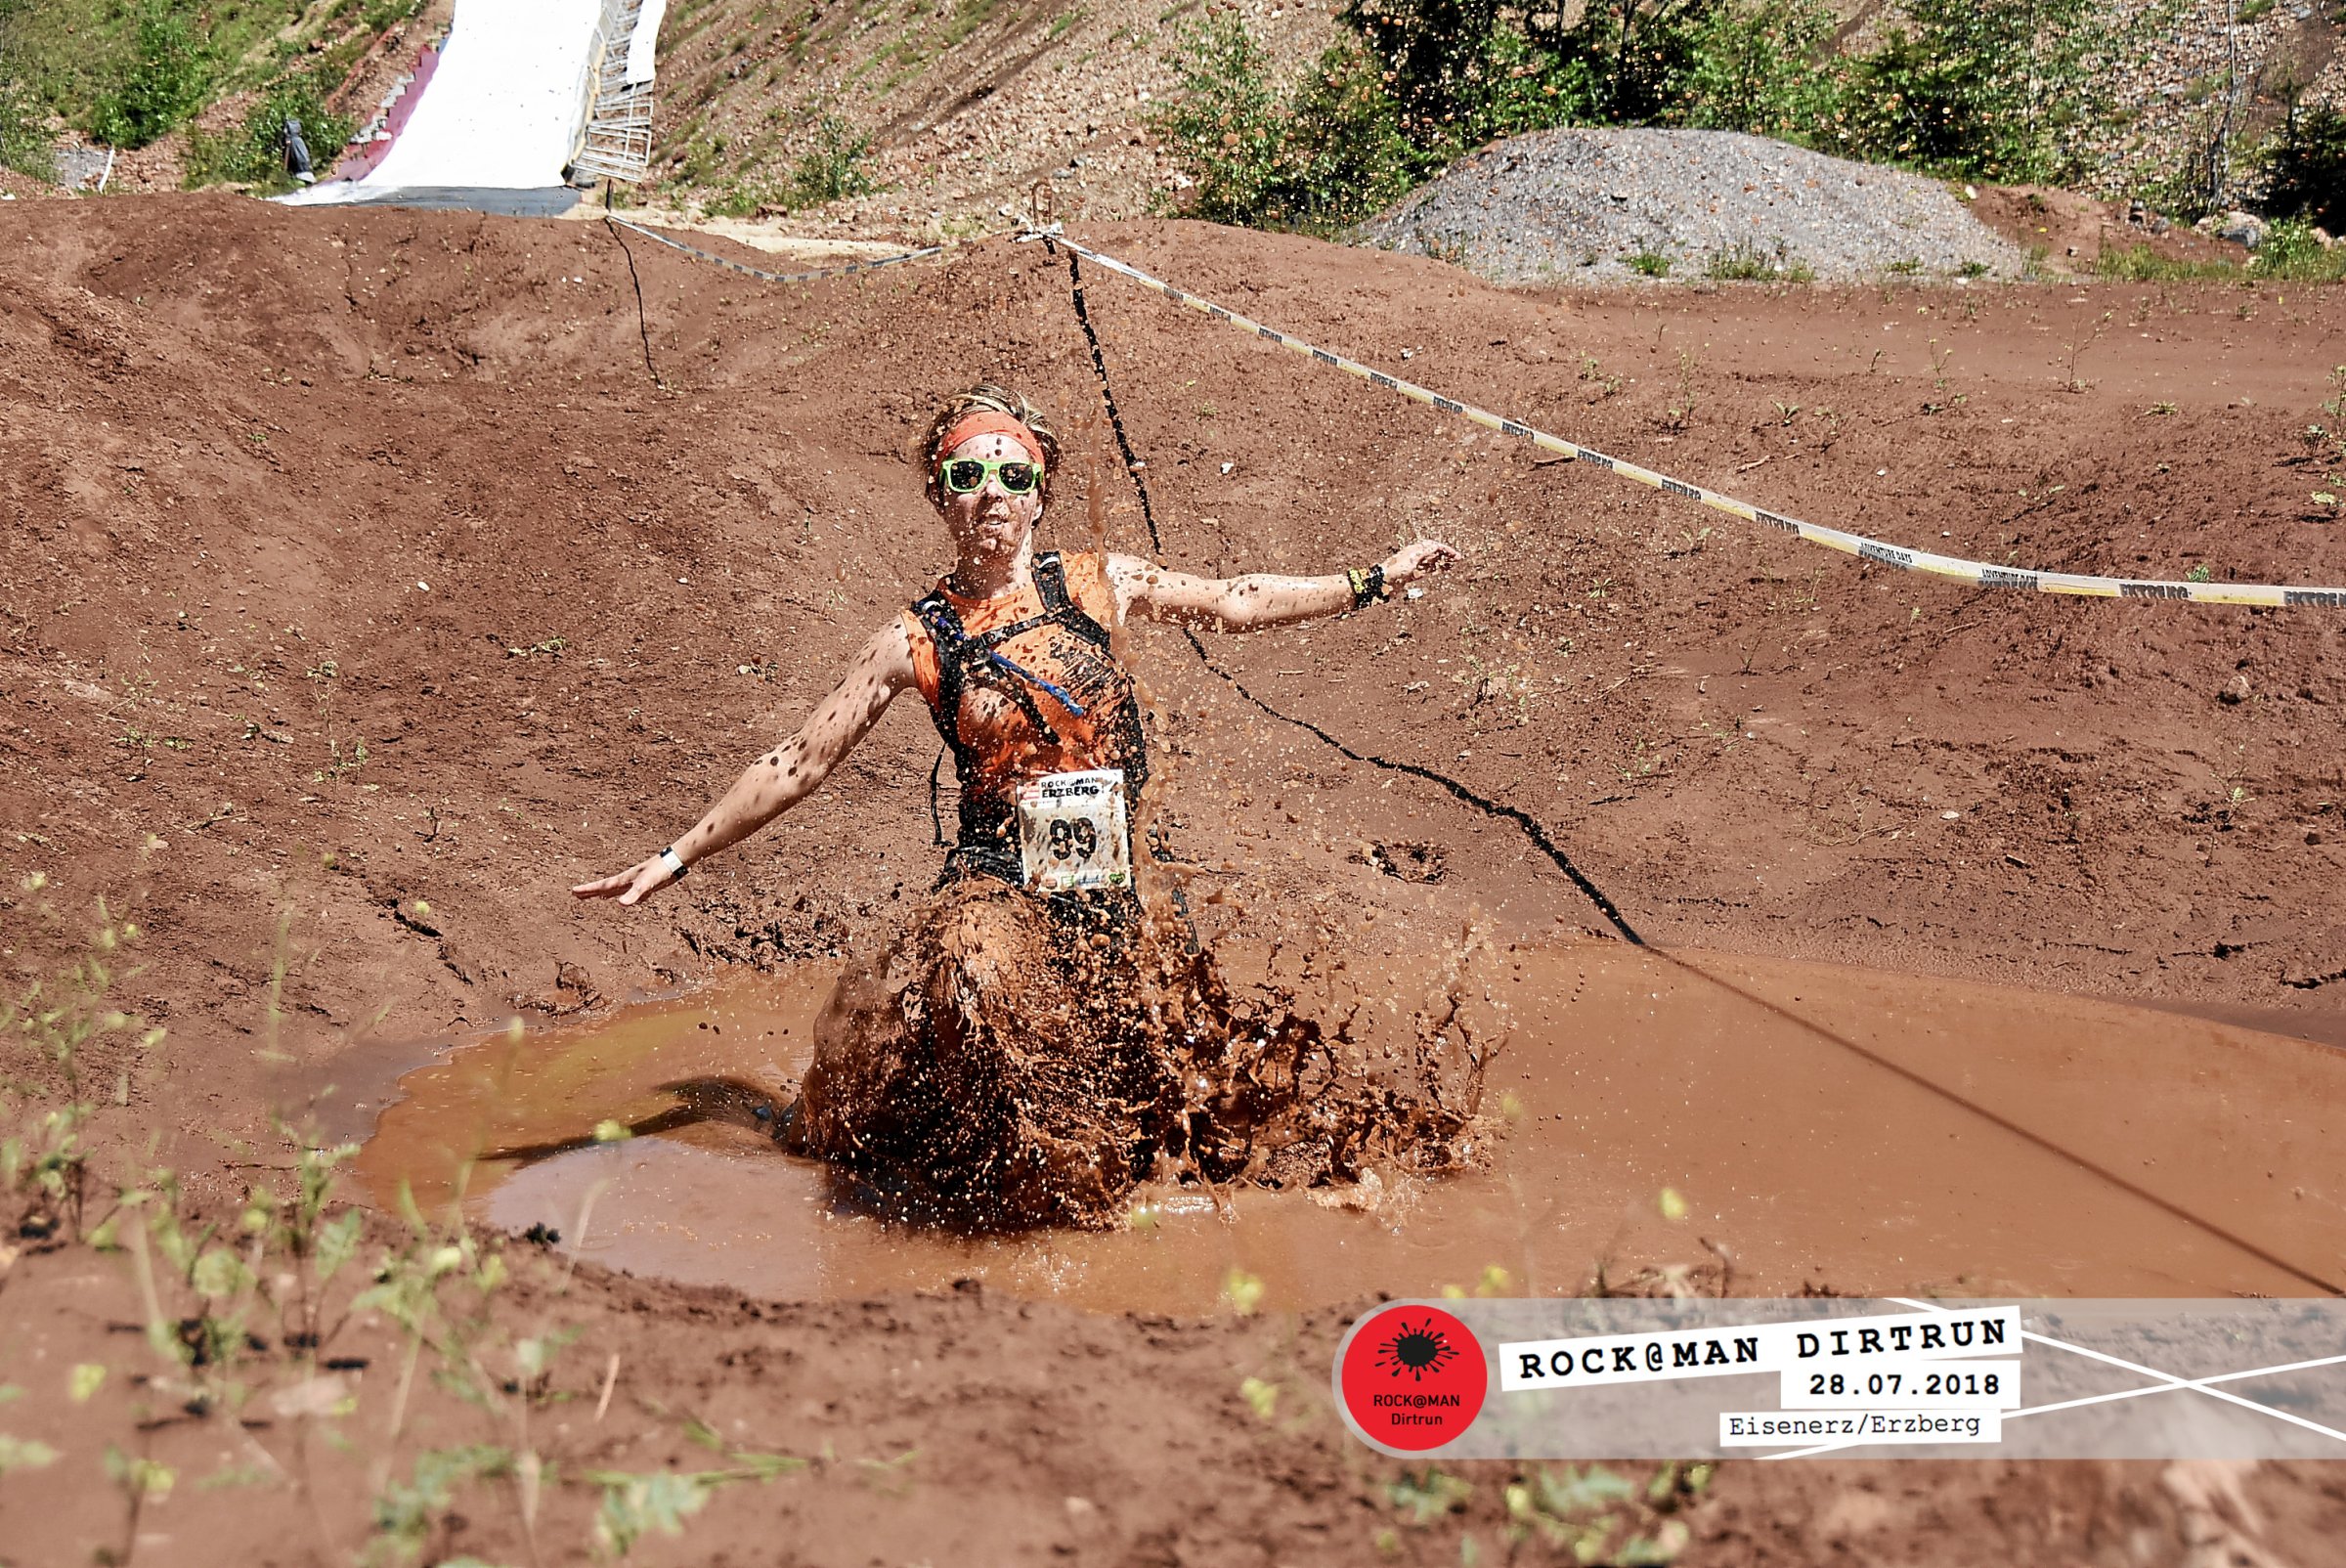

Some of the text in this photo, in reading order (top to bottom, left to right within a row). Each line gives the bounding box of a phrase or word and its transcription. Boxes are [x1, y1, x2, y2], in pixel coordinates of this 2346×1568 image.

[1895, 550, 1913, 564] DAYS
[1042, 786, 1100, 799] ERZBERG
[1049, 816, 1097, 861] 99
